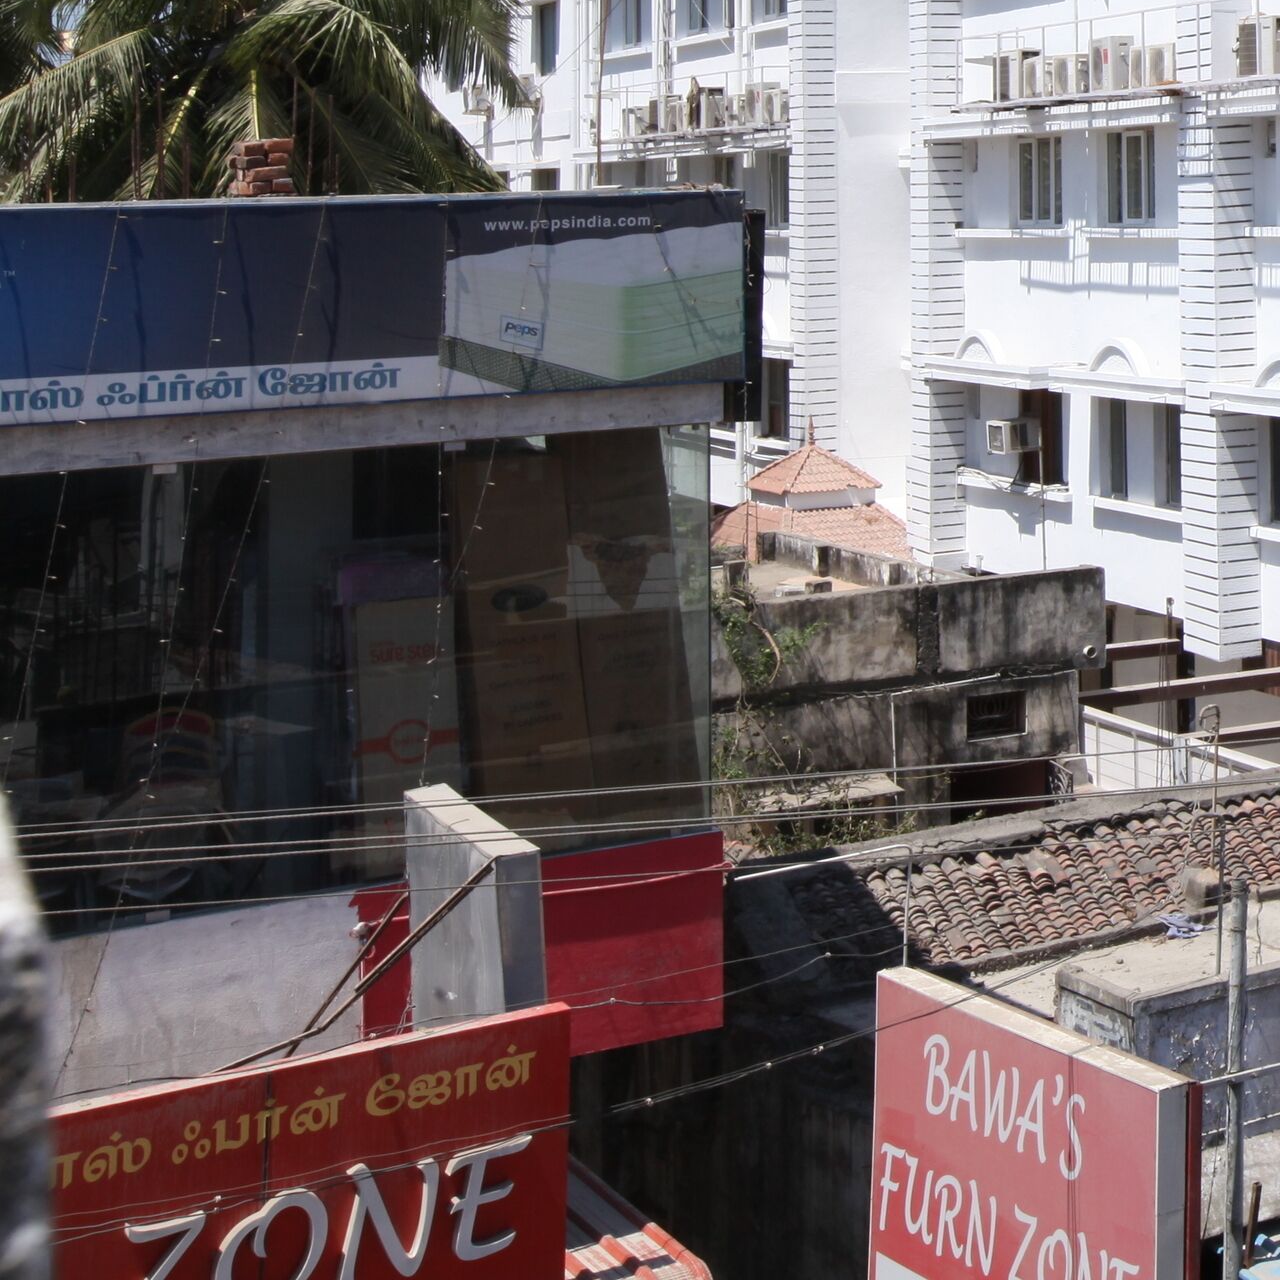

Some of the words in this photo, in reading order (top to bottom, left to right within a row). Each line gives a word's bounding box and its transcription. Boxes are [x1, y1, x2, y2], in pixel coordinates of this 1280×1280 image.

[484, 215, 651, 232] www.pepsindia.com
[504, 320, 538, 337] peps
[124, 1134, 532, 1280] ZONE
[879, 1141, 997, 1277] FURN
